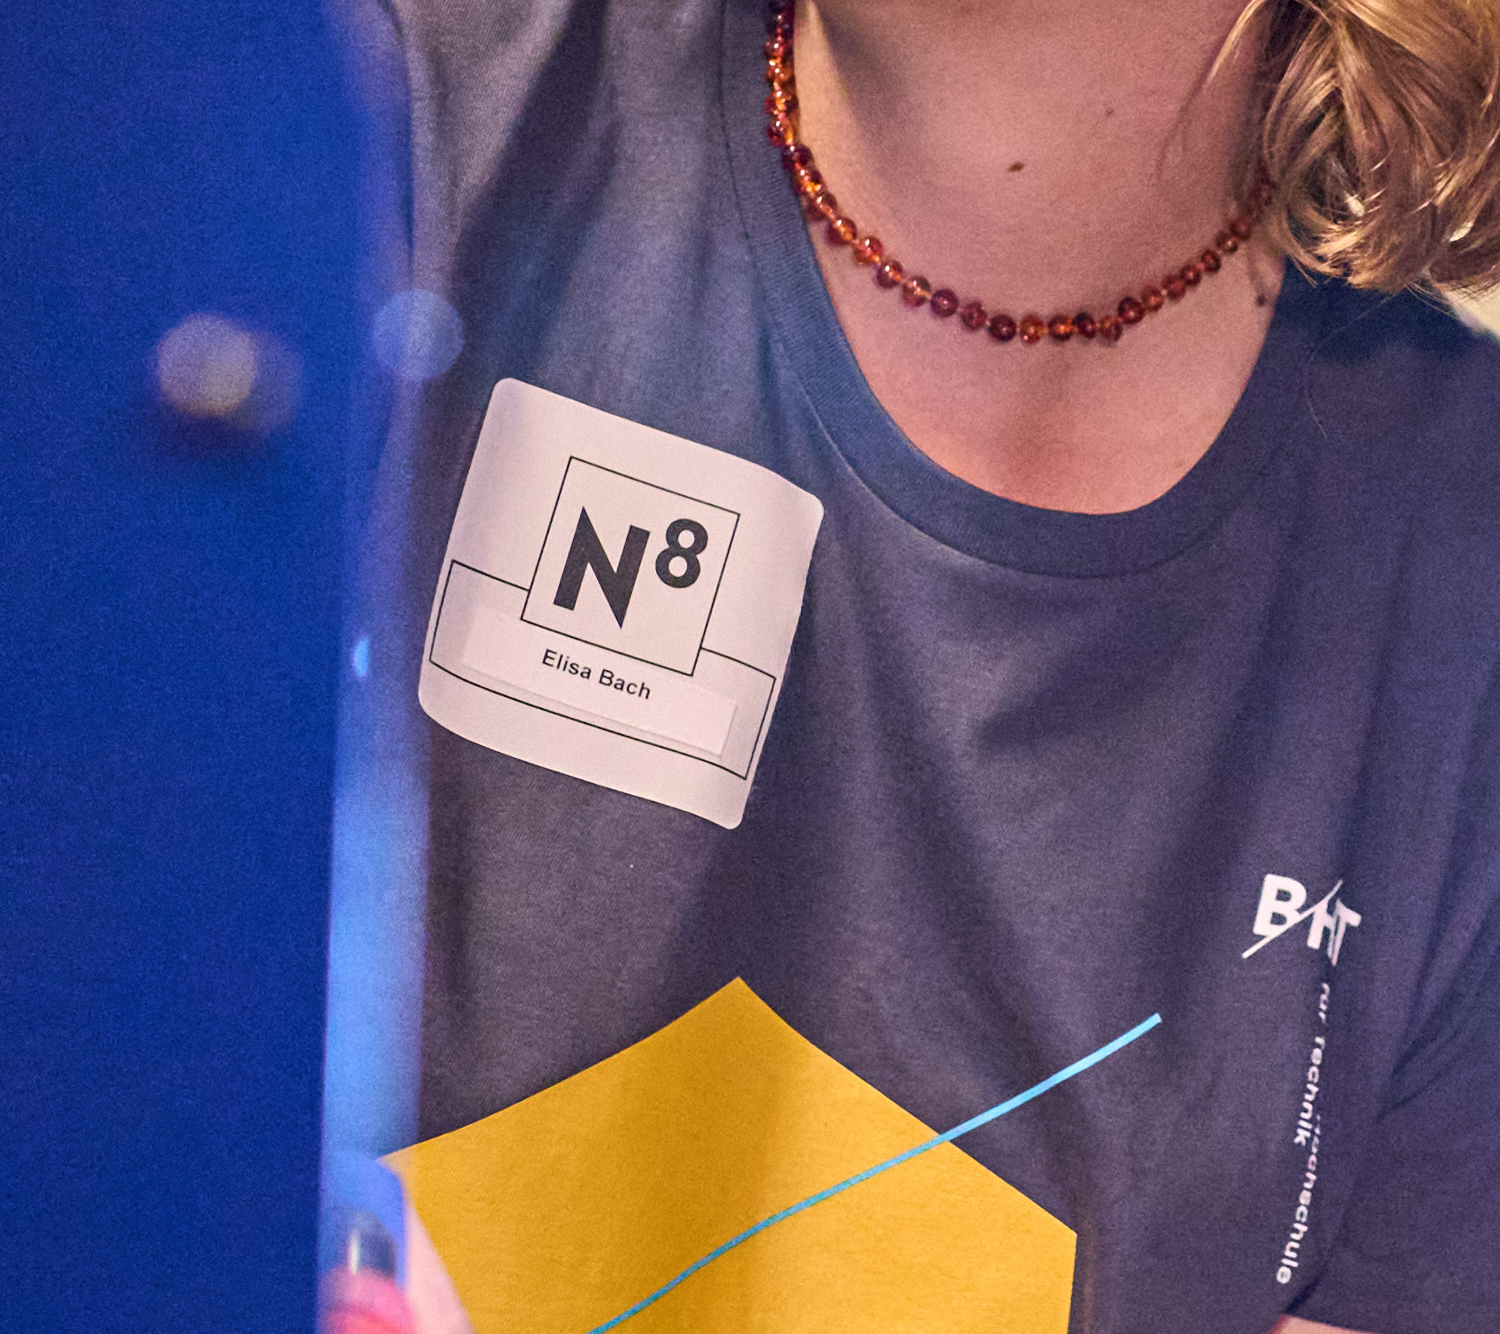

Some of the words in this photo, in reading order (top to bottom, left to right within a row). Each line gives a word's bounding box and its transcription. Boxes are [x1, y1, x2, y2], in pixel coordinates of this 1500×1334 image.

[553, 506, 708, 629] N8
[542, 649, 592, 679] Elisa
[598, 668, 651, 700] Bach
